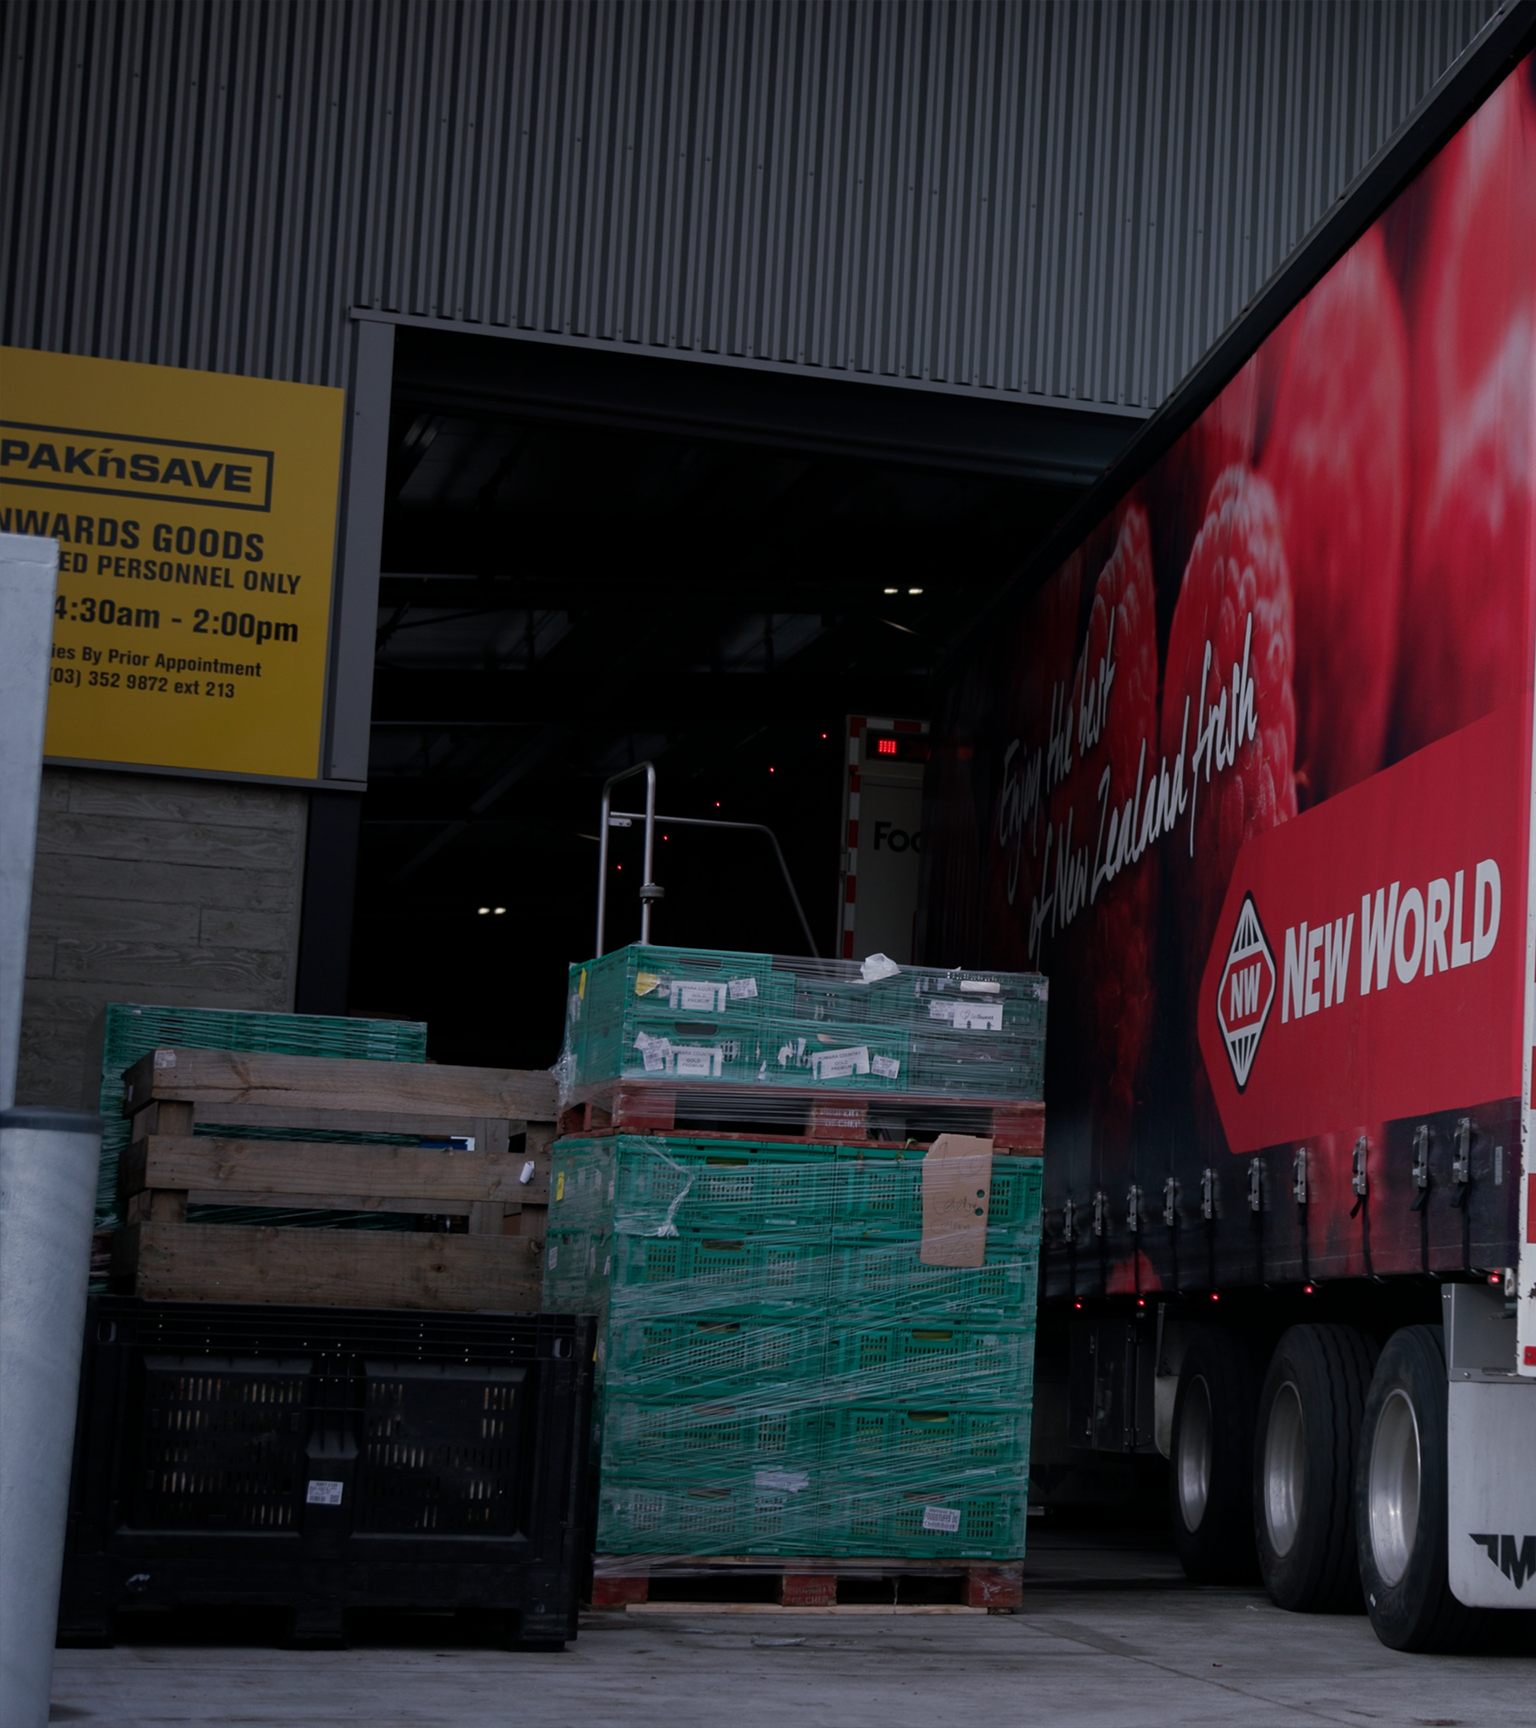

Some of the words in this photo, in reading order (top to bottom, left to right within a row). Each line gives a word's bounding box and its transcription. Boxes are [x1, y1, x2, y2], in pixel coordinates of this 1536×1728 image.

[0, 507, 140, 549] NWARDS
[153, 523, 264, 563] GOODS
[97, 554, 235, 590] PERSONNEL
[243, 569, 302, 596] ONLY
[55, 595, 160, 629] 4:30am
[192, 608, 299, 646] 2:00pm
[82, 646, 102, 666] By
[107, 648, 151, 667] Prior
[154, 654, 262, 678] Appointment
[88, 670, 121, 688] 352
[126, 674, 168, 693] 9872
[173, 679, 200, 696] ext
[205, 681, 235, 699] 213
[1078, 605, 1116, 757] best
[1052, 806, 1089, 939] New
[1090, 694, 1189, 906] Zealand
[1190, 611, 1258, 859] fresh
[1281, 912, 1355, 1024] NEW
[1360, 858, 1502, 997] WORLD
[1229, 962, 1262, 1022] NW
